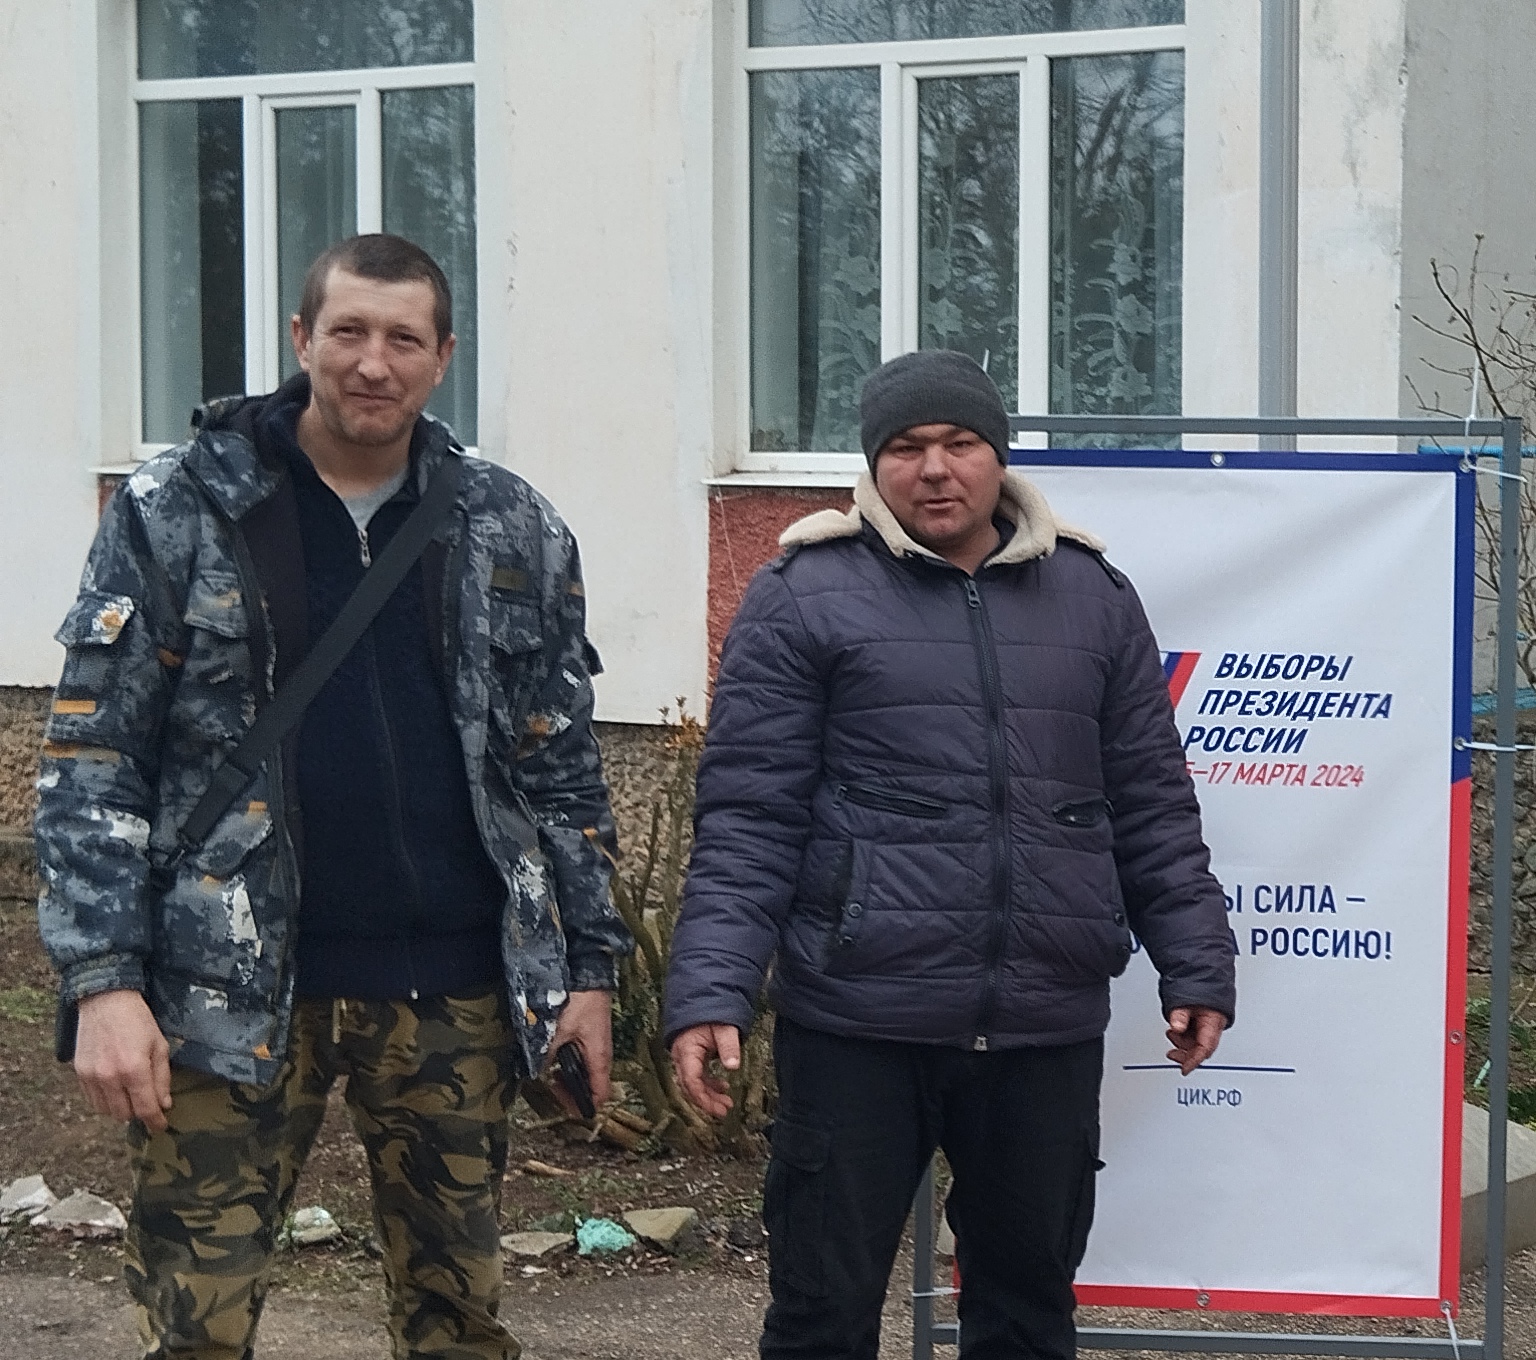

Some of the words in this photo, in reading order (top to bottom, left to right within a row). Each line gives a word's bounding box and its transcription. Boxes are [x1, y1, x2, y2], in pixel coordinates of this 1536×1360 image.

[1214, 652, 1353, 682] ВЫБОРЫ
[1198, 690, 1393, 722] ПРЕЗИДЕНТА
[1183, 726, 1308, 754] РОССИИ
[1232, 762, 1308, 786] МАРТА
[1310, 764, 1364, 788] 2024
[1253, 884, 1337, 914] СИЛА
[1250, 926, 1392, 961] РОССИЮ!
[1176, 1087, 1242, 1108] ЦИК.РФ
